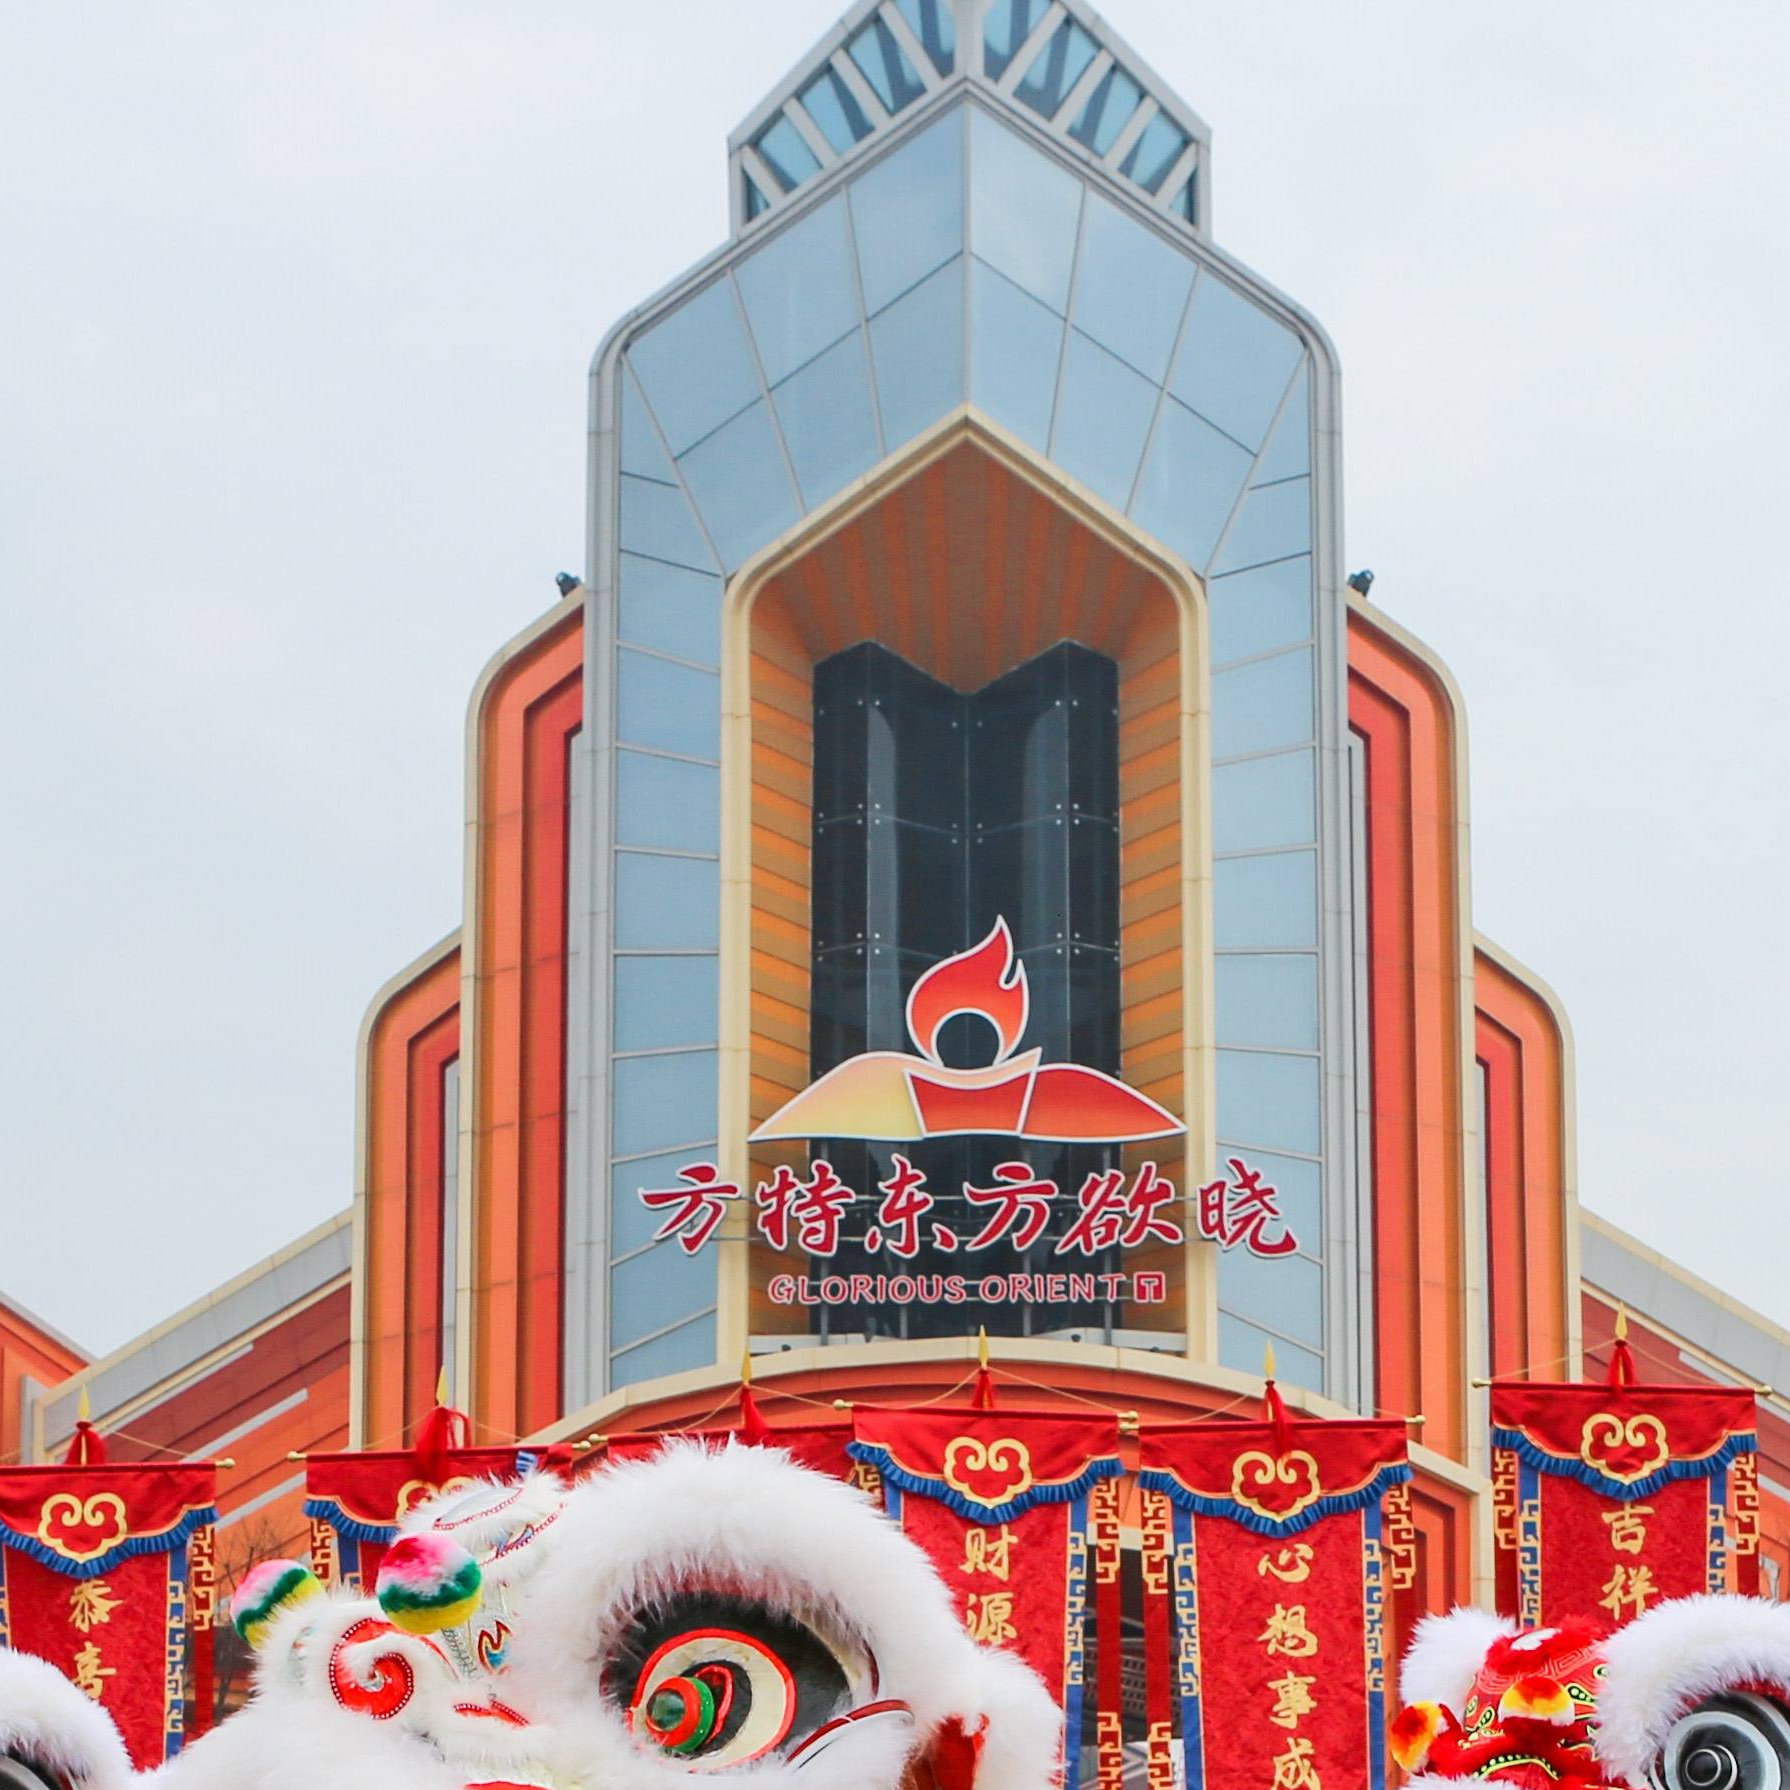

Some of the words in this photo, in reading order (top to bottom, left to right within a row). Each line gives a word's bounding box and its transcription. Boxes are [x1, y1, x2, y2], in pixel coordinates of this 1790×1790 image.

[638, 1154, 1299, 1258] 方特东方欲晓
[767, 1272, 967, 1305] GLORIOUS
[978, 1272, 1127, 1304] ORIENT
[959, 1524, 1019, 1646] 财源
[1598, 1502, 1659, 1621] 吉祥
[68, 1579, 124, 1700] 恭喜
